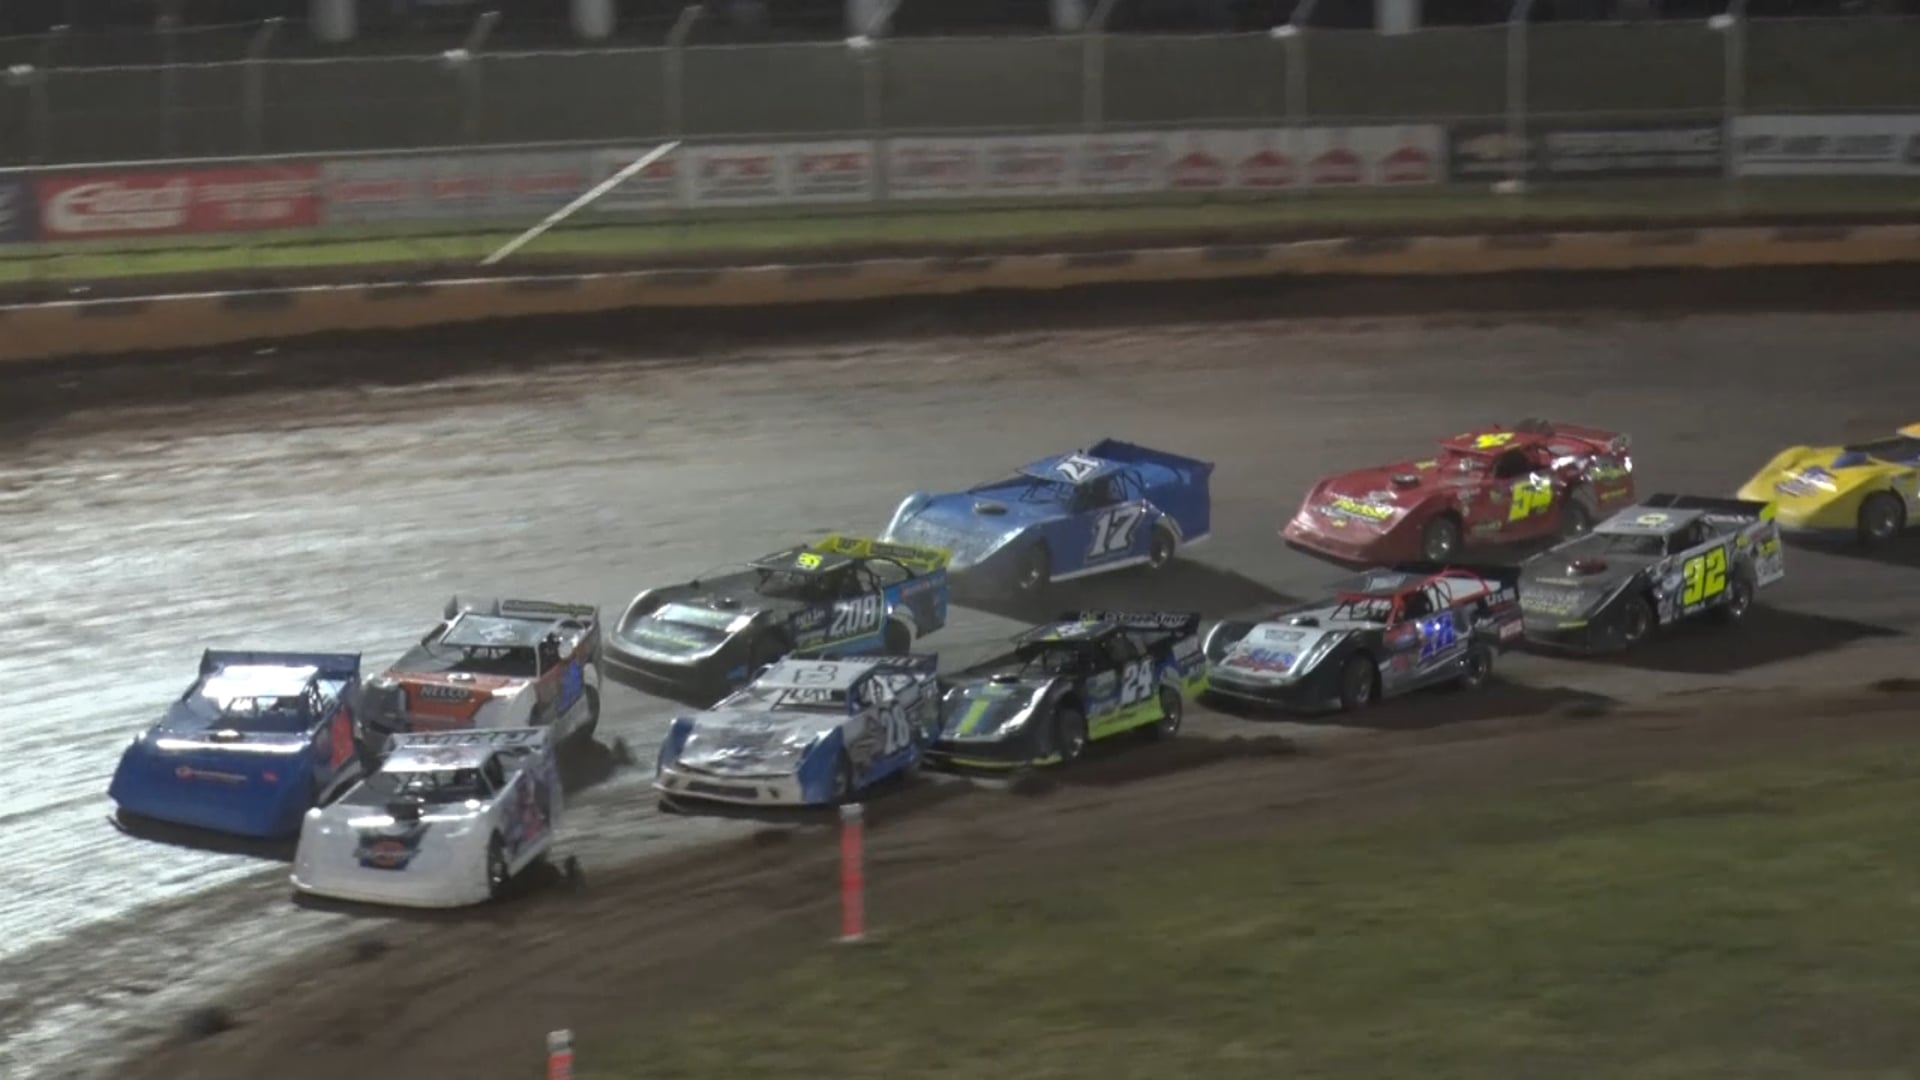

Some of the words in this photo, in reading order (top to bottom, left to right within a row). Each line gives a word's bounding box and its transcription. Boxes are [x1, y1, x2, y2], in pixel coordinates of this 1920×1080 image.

[1089, 506, 1142, 557] 17
[1682, 545, 1726, 606] 32
[829, 595, 877, 637] 208
[1121, 657, 1153, 704] 24
